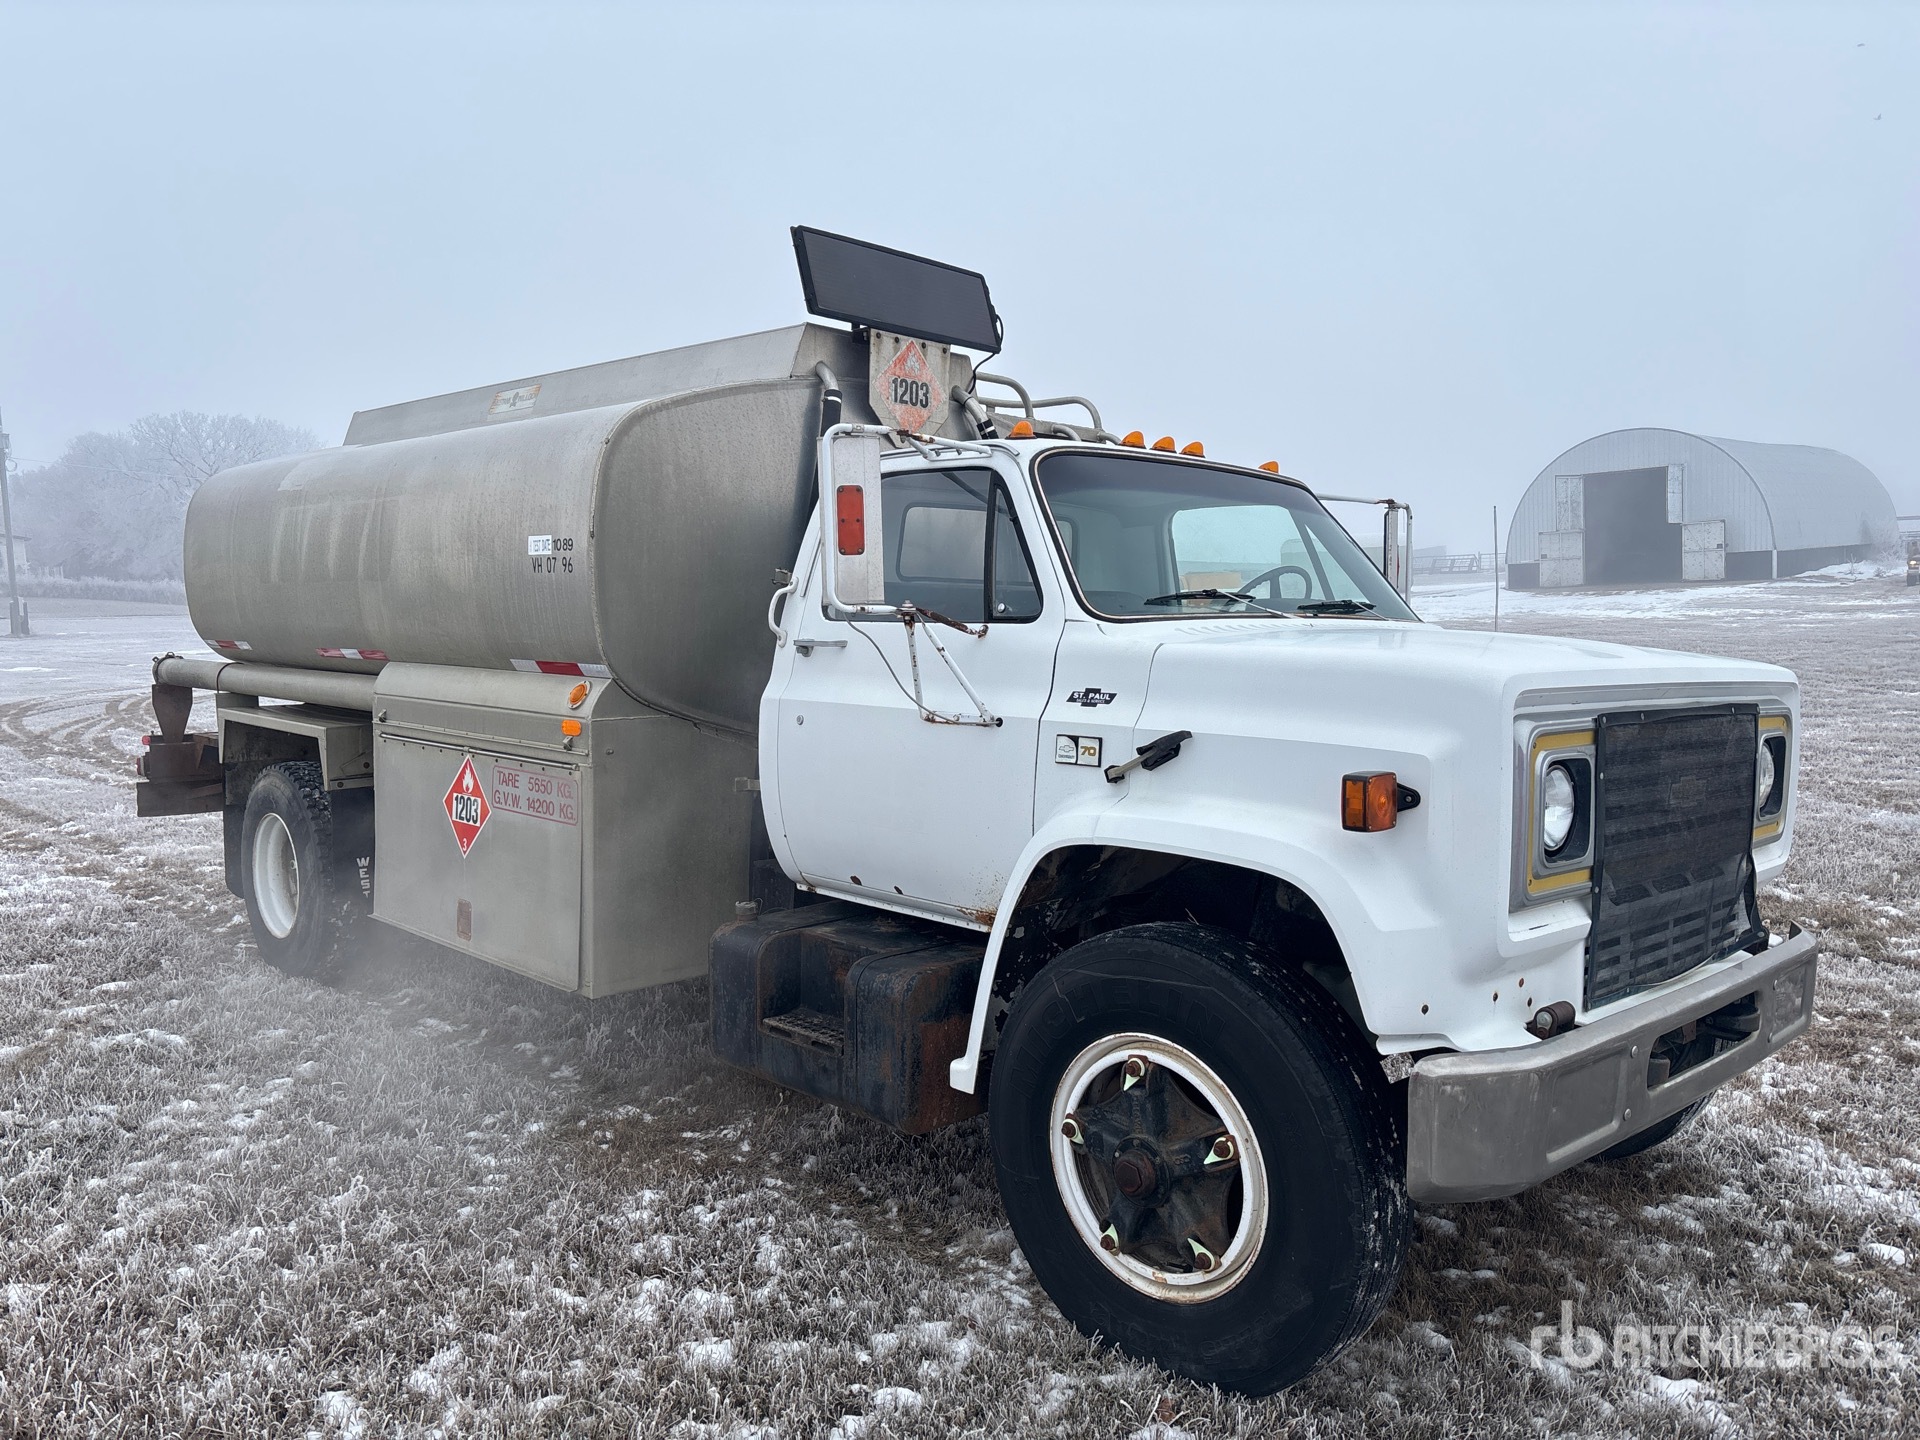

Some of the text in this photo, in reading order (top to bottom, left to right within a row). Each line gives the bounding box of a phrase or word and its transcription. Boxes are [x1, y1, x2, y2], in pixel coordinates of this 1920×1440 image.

[891, 377, 930, 408] 1203
[531, 557, 574, 573] VH 07 96
[1088, 693, 1111, 701] PAUL
[1080, 746, 1097, 756] 70
[497, 770, 574, 800] TARE 5650 KG.
[454, 794, 479, 825] 1203
[493, 790, 576, 822] G.V.W. 14200 KG.
[463, 838, 468, 851] 3
[1010, 978, 1227, 1099] MICHELIN
